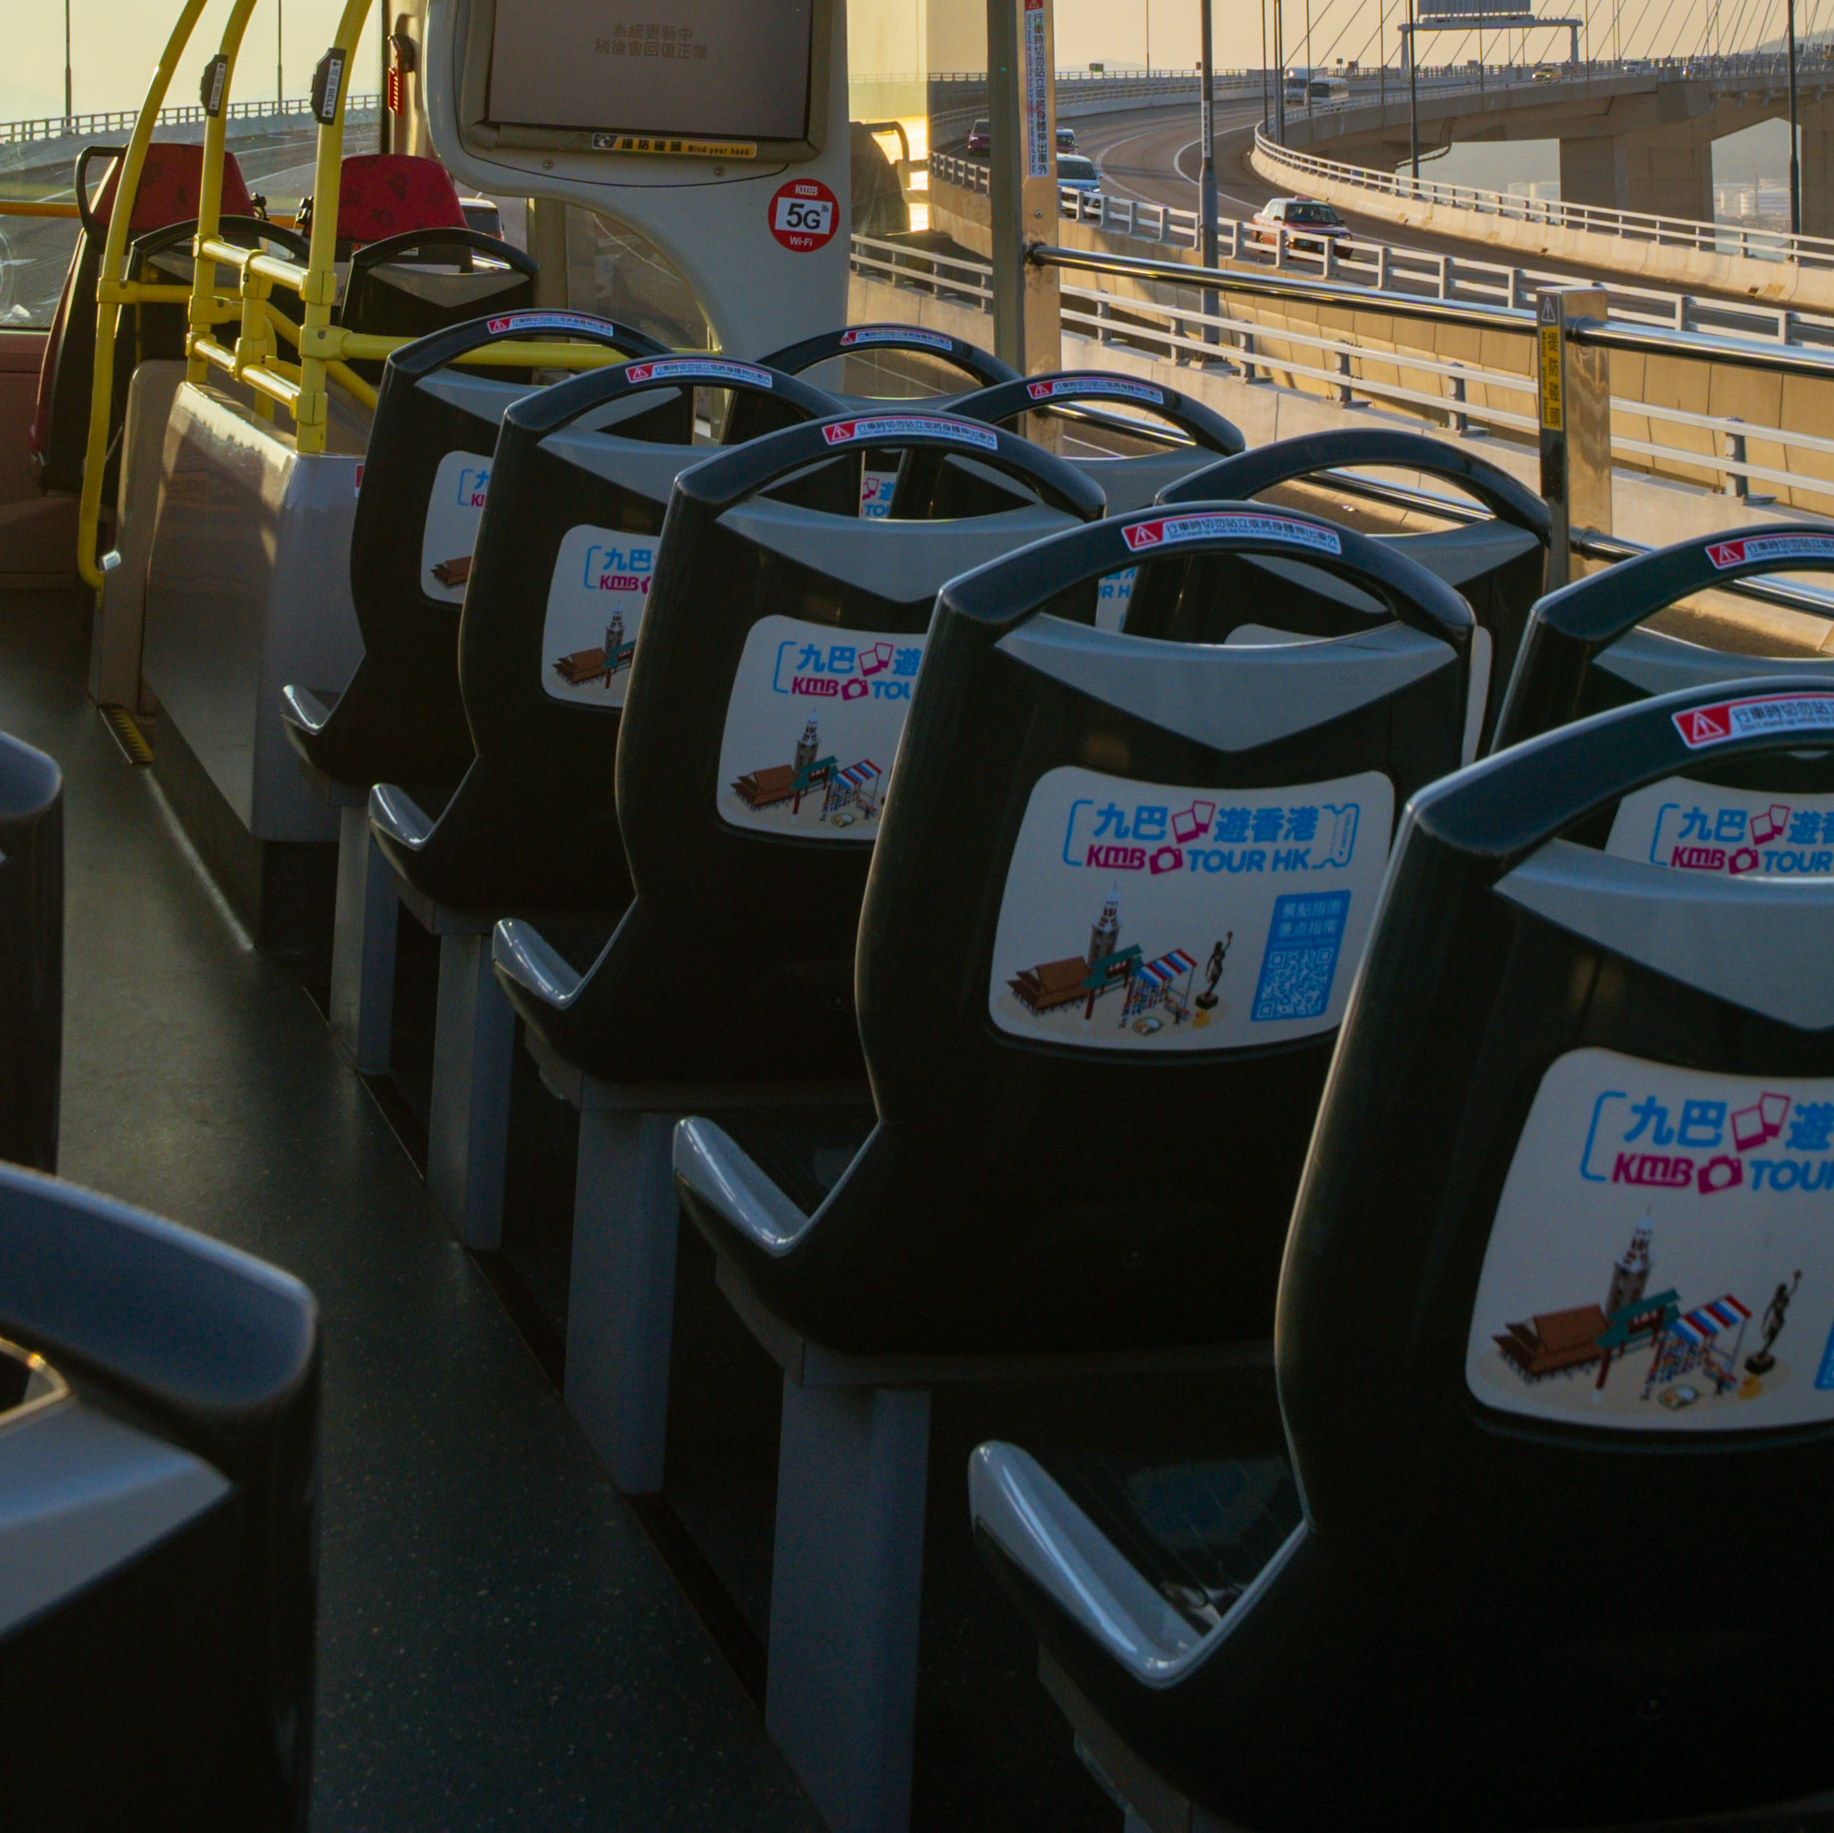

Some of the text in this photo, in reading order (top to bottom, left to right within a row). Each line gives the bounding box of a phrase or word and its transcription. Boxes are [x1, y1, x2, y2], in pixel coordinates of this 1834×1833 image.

[612, 22, 694, 40] 系統更新中
[687, 144, 707, 154] Mind
[795, 184, 818, 196] KMB
[785, 203, 822, 230] 5G
[789, 236, 813, 247] Wi-Fi
[603, 547, 652, 572] 九巴
[599, 575, 639, 592] KMB
[797, 643, 856, 674] 九巴
[791, 676, 840, 697] KMB
[1093, 803, 1319, 843] 九巴 遊香港
[1680, 805, 1749, 843] 九巴
[1086, 844, 1311, 873] KMB TOUR HK
[1670, 846, 1727, 870] KMB
[1762, 850, 1834, 873] TOUR
[1624, 1095, 1727, 1148] 九巴
[1611, 1152, 1694, 1188] KMB
